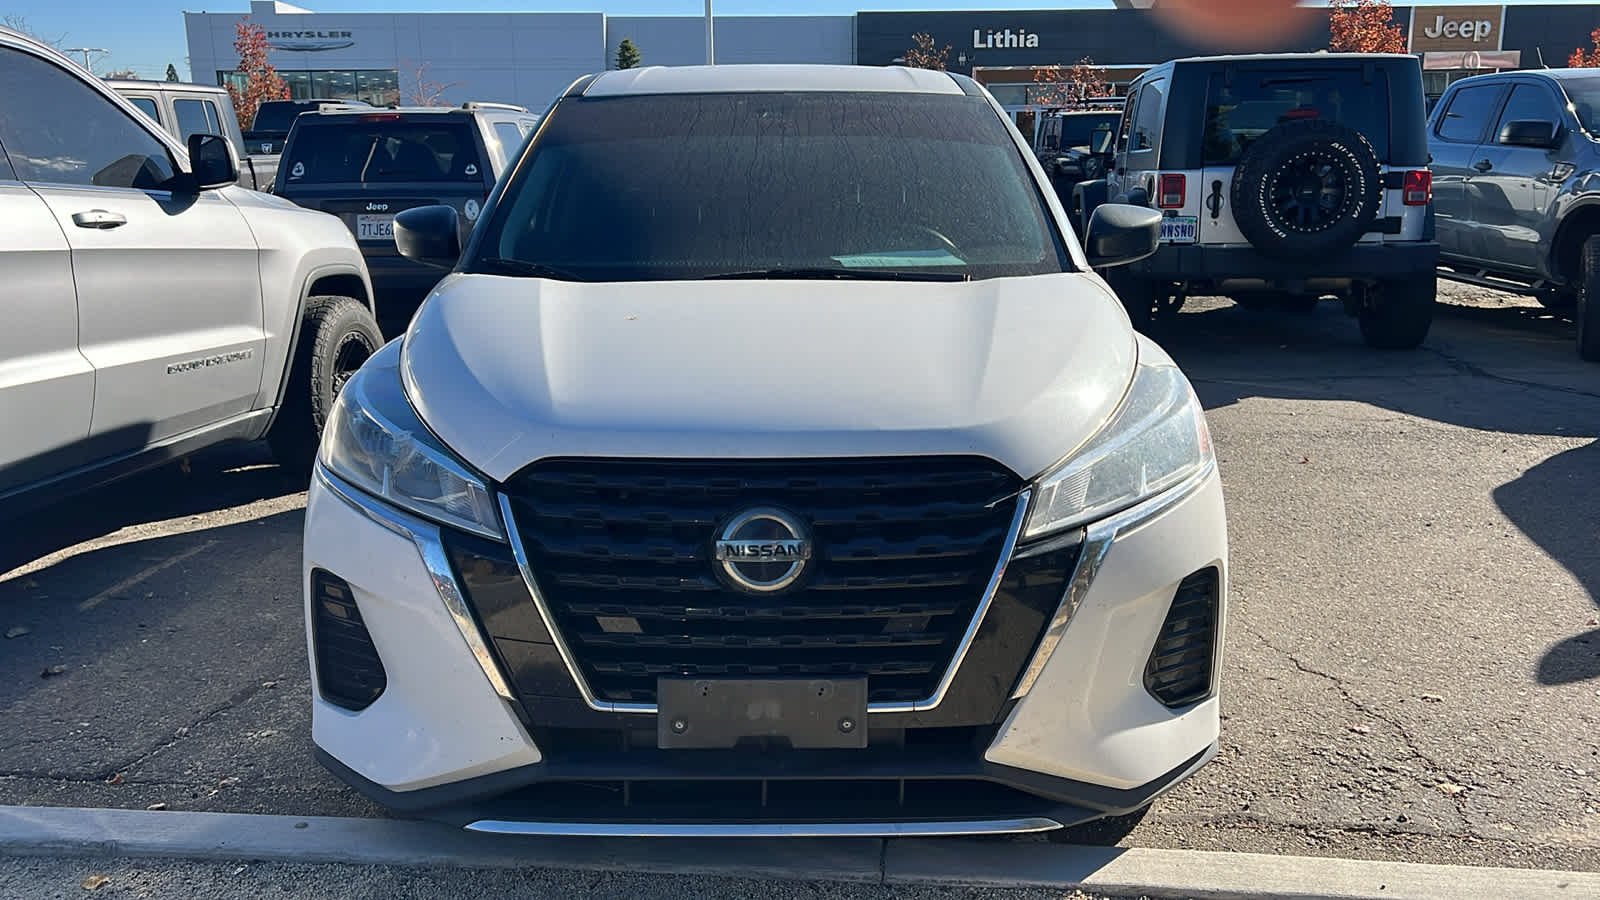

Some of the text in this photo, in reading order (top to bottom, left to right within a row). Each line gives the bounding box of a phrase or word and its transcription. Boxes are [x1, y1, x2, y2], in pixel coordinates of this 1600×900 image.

[265, 31, 353, 39] HRYSLER
[1424, 15, 1492, 42] Jeep
[973, 28, 1039, 49] Lithia
[366, 202, 389, 212] Jeep
[360, 223, 394, 236] 7TJE6
[726, 544, 802, 557] NISSAN
